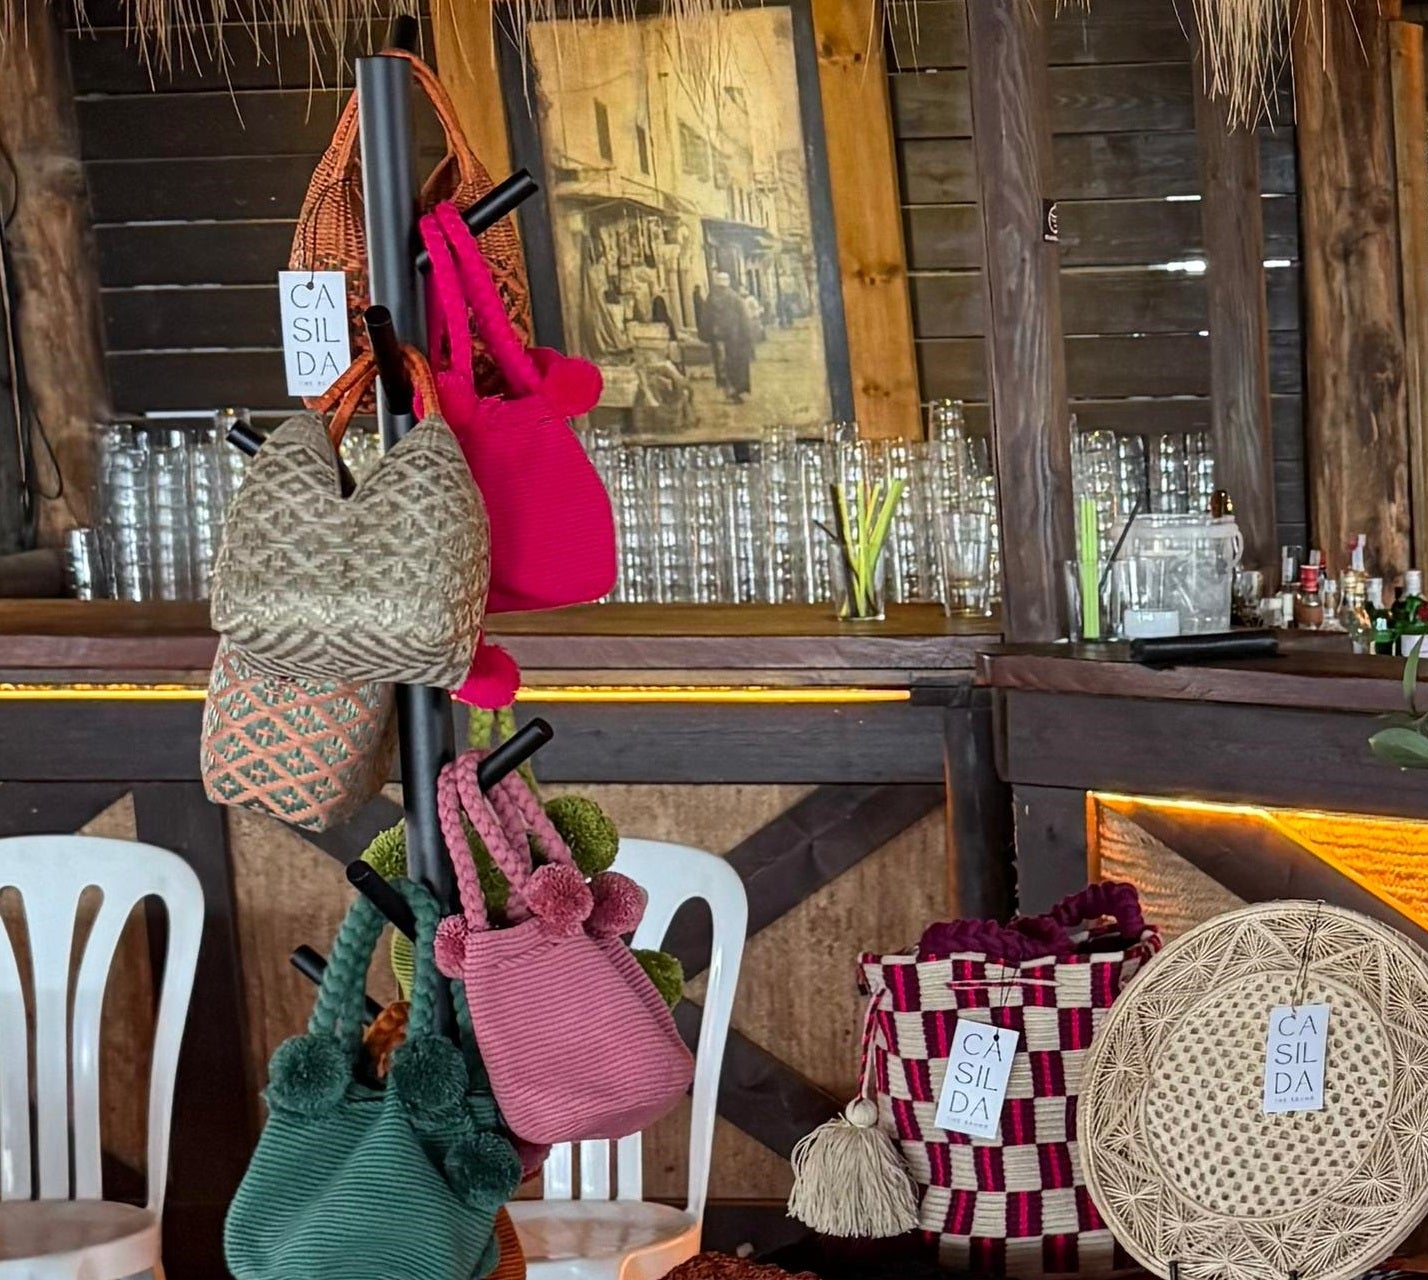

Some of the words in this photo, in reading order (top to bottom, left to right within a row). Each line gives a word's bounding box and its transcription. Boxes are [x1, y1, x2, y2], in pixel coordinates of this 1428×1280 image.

[290, 283, 335, 309] CA
[292, 317, 341, 343] SIL
[296, 351, 340, 376] DA
[1278, 1014, 1317, 1036] CA
[962, 1032, 1002, 1062] CA
[1274, 1041, 1317, 1065] SIL
[954, 1061, 998, 1092] SIL
[1274, 1070, 1313, 1095] DA
[949, 1090, 989, 1120] DA
